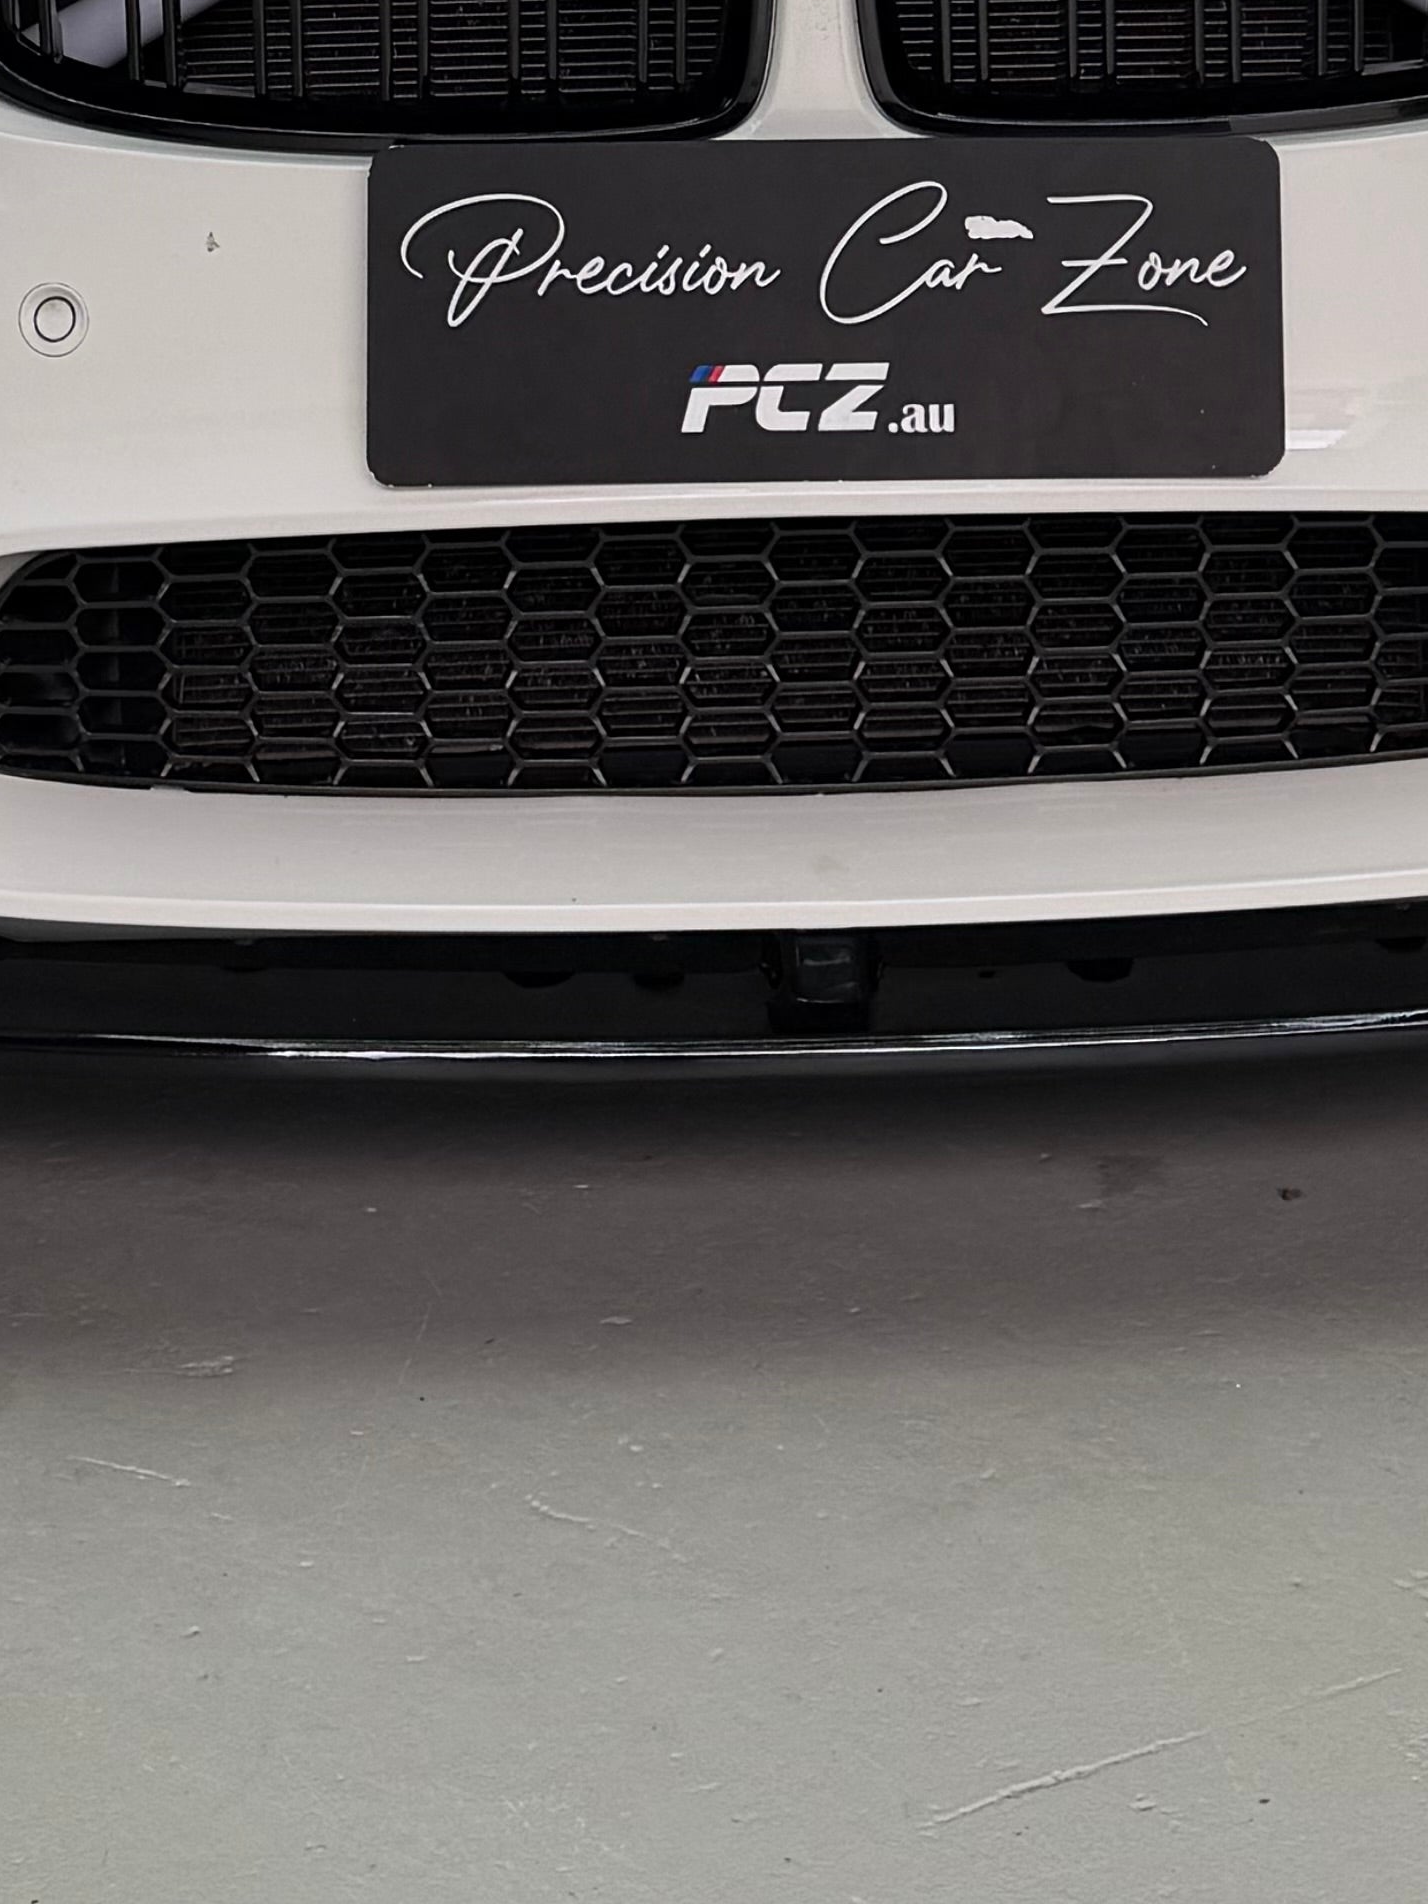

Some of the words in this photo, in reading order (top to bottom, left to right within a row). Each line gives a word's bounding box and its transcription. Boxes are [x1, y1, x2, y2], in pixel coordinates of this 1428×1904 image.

[400, 193, 781, 328] Precision
[819, 180, 1000, 325] Car
[1040, 193, 1247, 327] Zone
